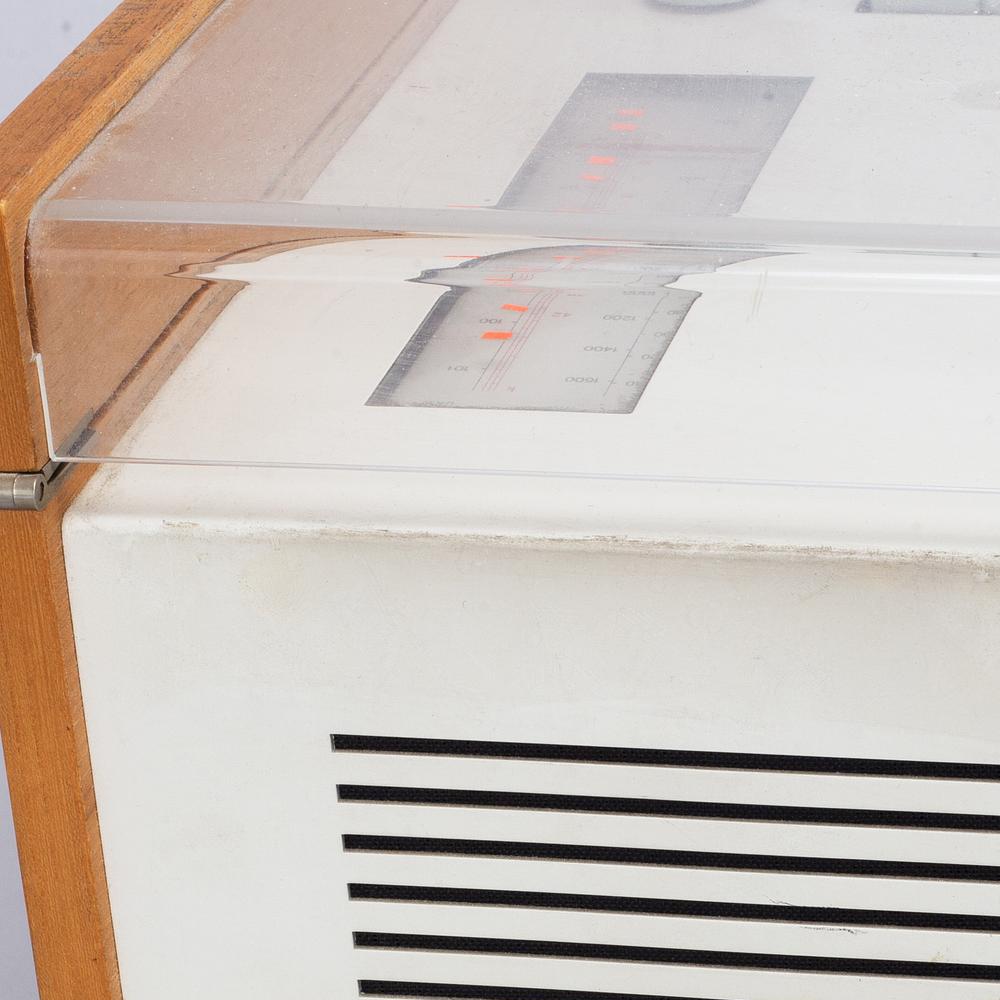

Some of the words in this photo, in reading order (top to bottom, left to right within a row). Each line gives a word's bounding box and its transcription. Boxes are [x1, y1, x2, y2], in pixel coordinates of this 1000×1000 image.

[583, 344, 617, 353] 1400
[447, 364, 469, 372] 101
[565, 376, 599, 384] 1600
